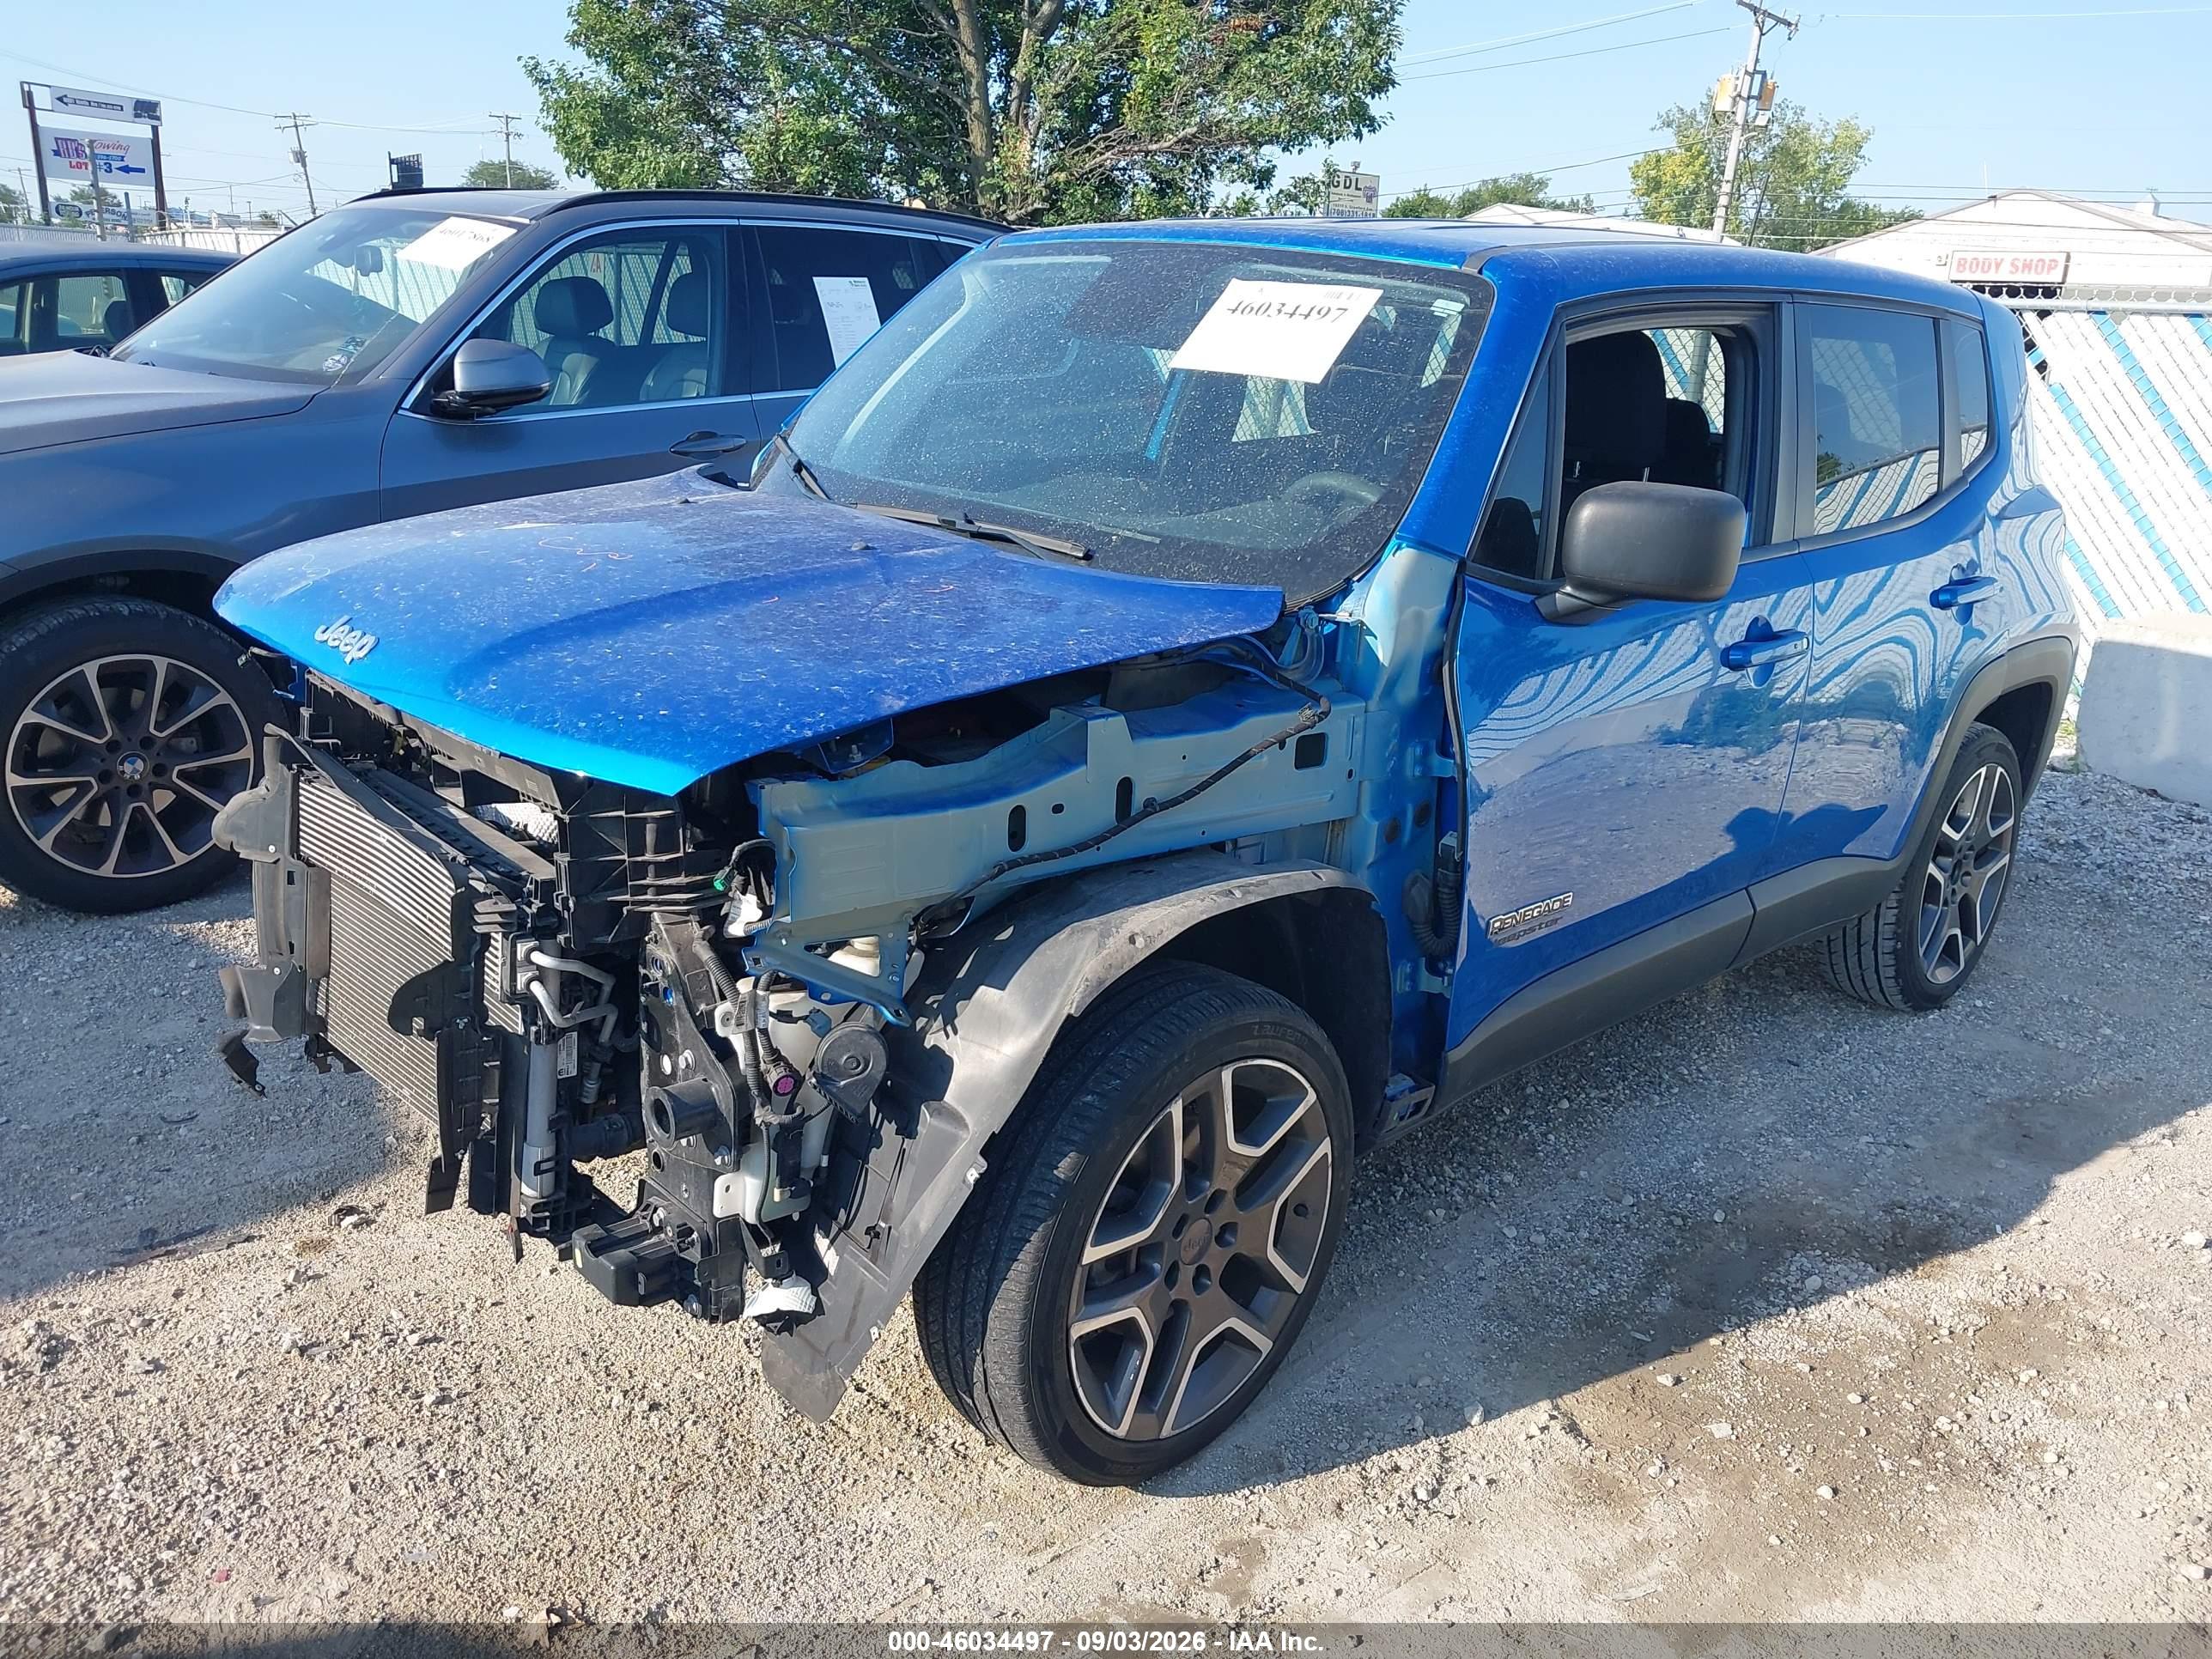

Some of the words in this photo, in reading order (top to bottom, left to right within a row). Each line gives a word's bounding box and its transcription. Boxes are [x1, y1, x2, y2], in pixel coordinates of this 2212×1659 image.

[69, 161, 88, 170] LOT
[1332, 174, 1362, 191] GDL
[1956, 258, 2004, 274] BODY
[2009, 258, 2059, 275] SHOP
[1227, 301, 1349, 323] 46034497
[314, 615, 380, 665] Jeep
[1487, 892, 1572, 938] RENEGADE
